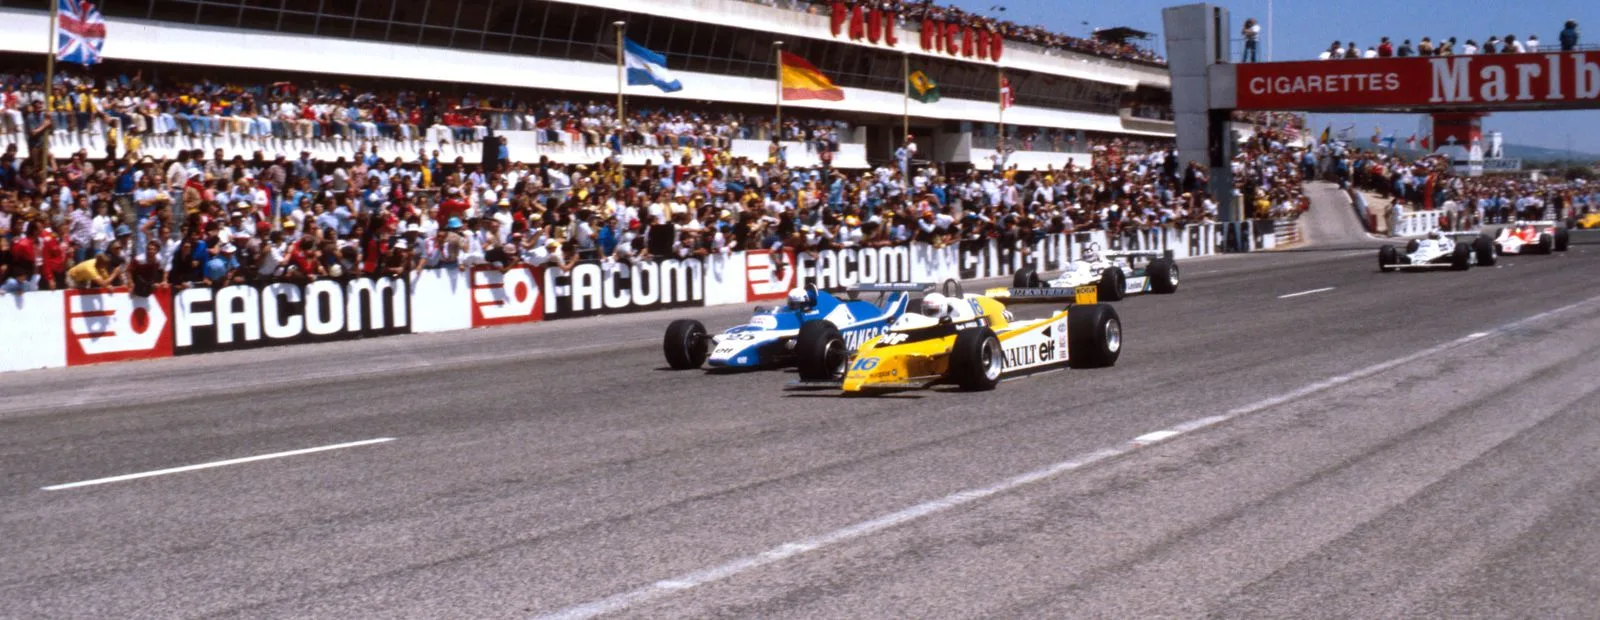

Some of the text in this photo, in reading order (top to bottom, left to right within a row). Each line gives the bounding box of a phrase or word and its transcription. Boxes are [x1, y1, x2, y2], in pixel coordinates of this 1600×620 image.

[830, 2, 1004, 63] PAUL RICARD
[1249, 53, 1600, 103] CIGARETTES Marlb
[543, 257, 704, 314] FACOM
[800, 246, 910, 290] FACOM
[174, 276, 408, 347] FACOM
[967, 297, 985, 316] 16
[851, 356, 880, 371] 16
[1000, 344, 1037, 369] NAULT
[1039, 339, 1056, 361] elf
